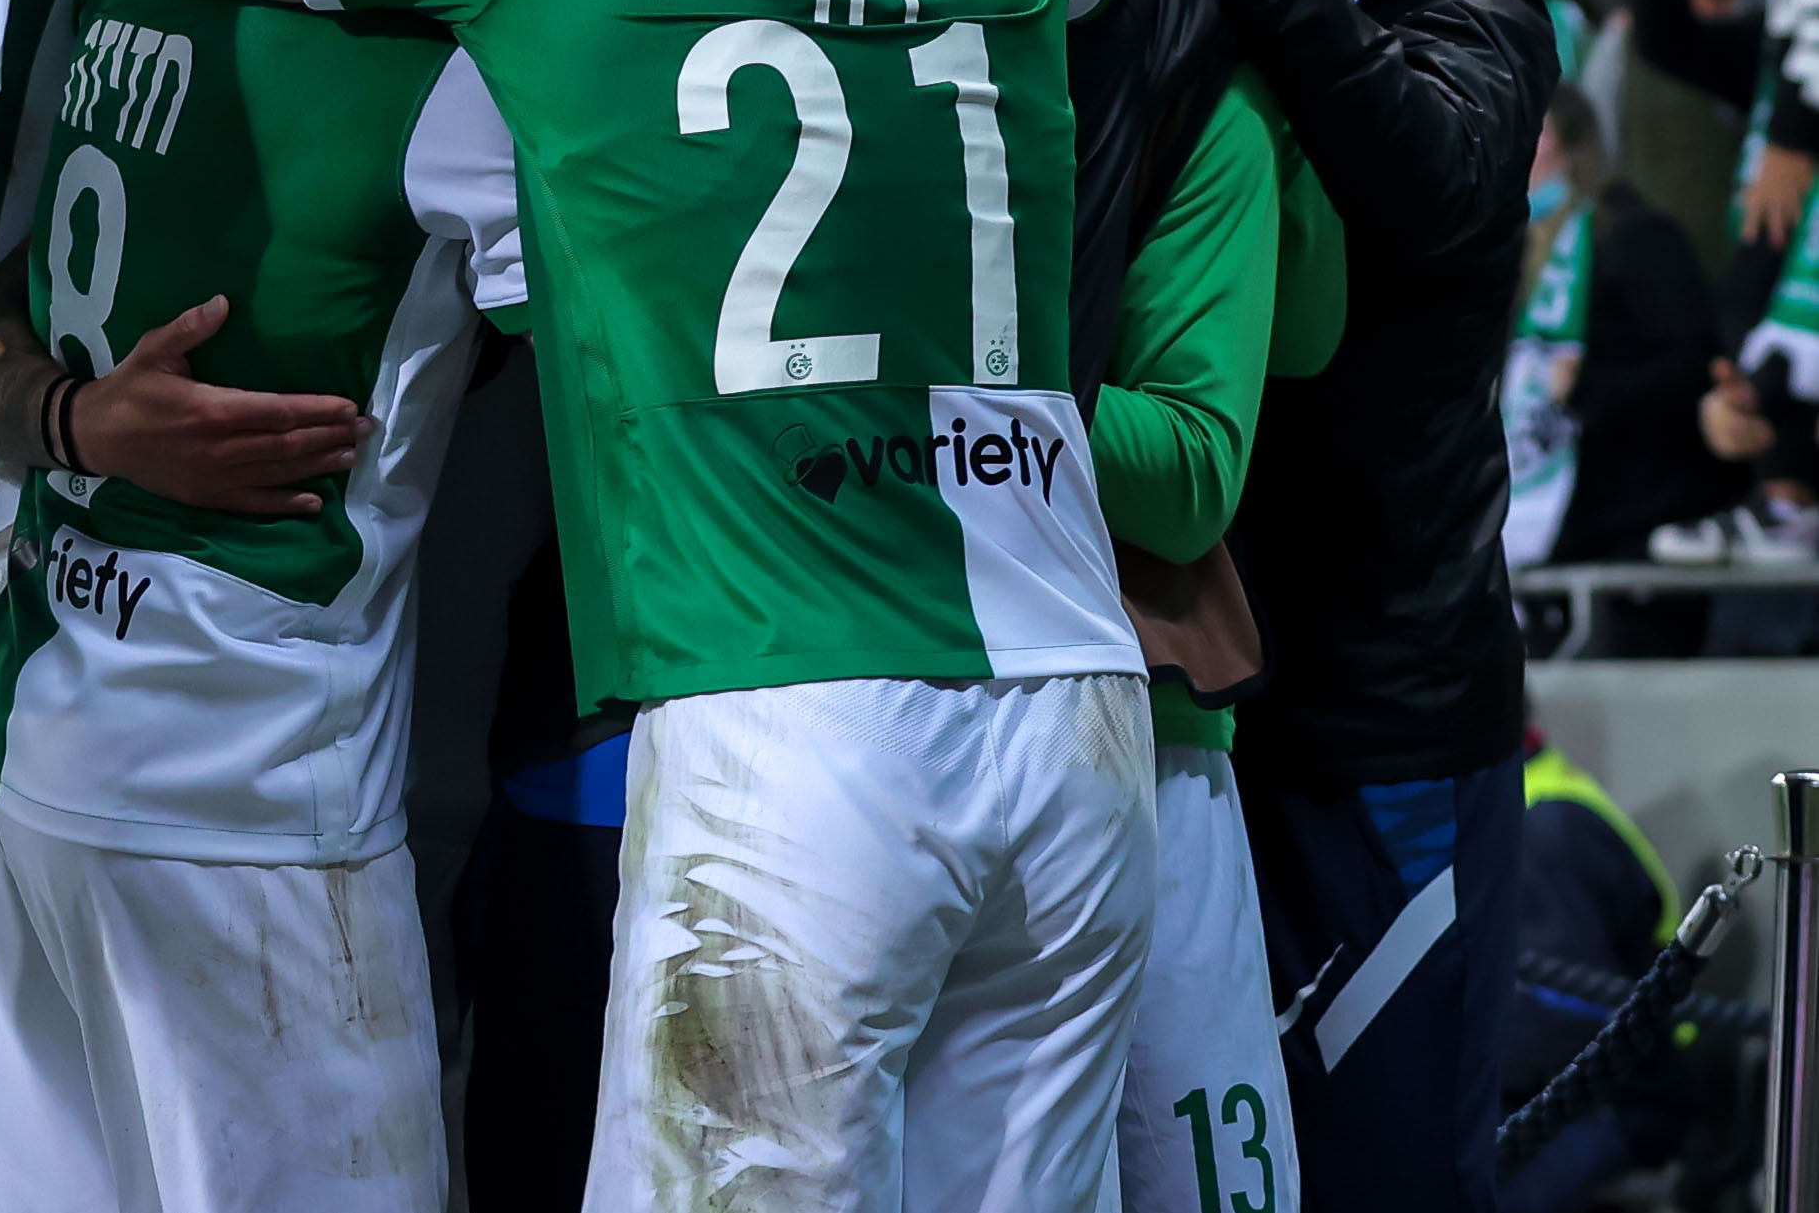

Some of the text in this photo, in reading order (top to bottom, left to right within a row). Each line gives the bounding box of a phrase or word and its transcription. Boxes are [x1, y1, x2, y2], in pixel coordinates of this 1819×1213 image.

[48, 143, 127, 510] 8
[676, 18, 1020, 396] 21
[845, 416, 1065, 508] variety
[1173, 1082, 1276, 1213] 13
